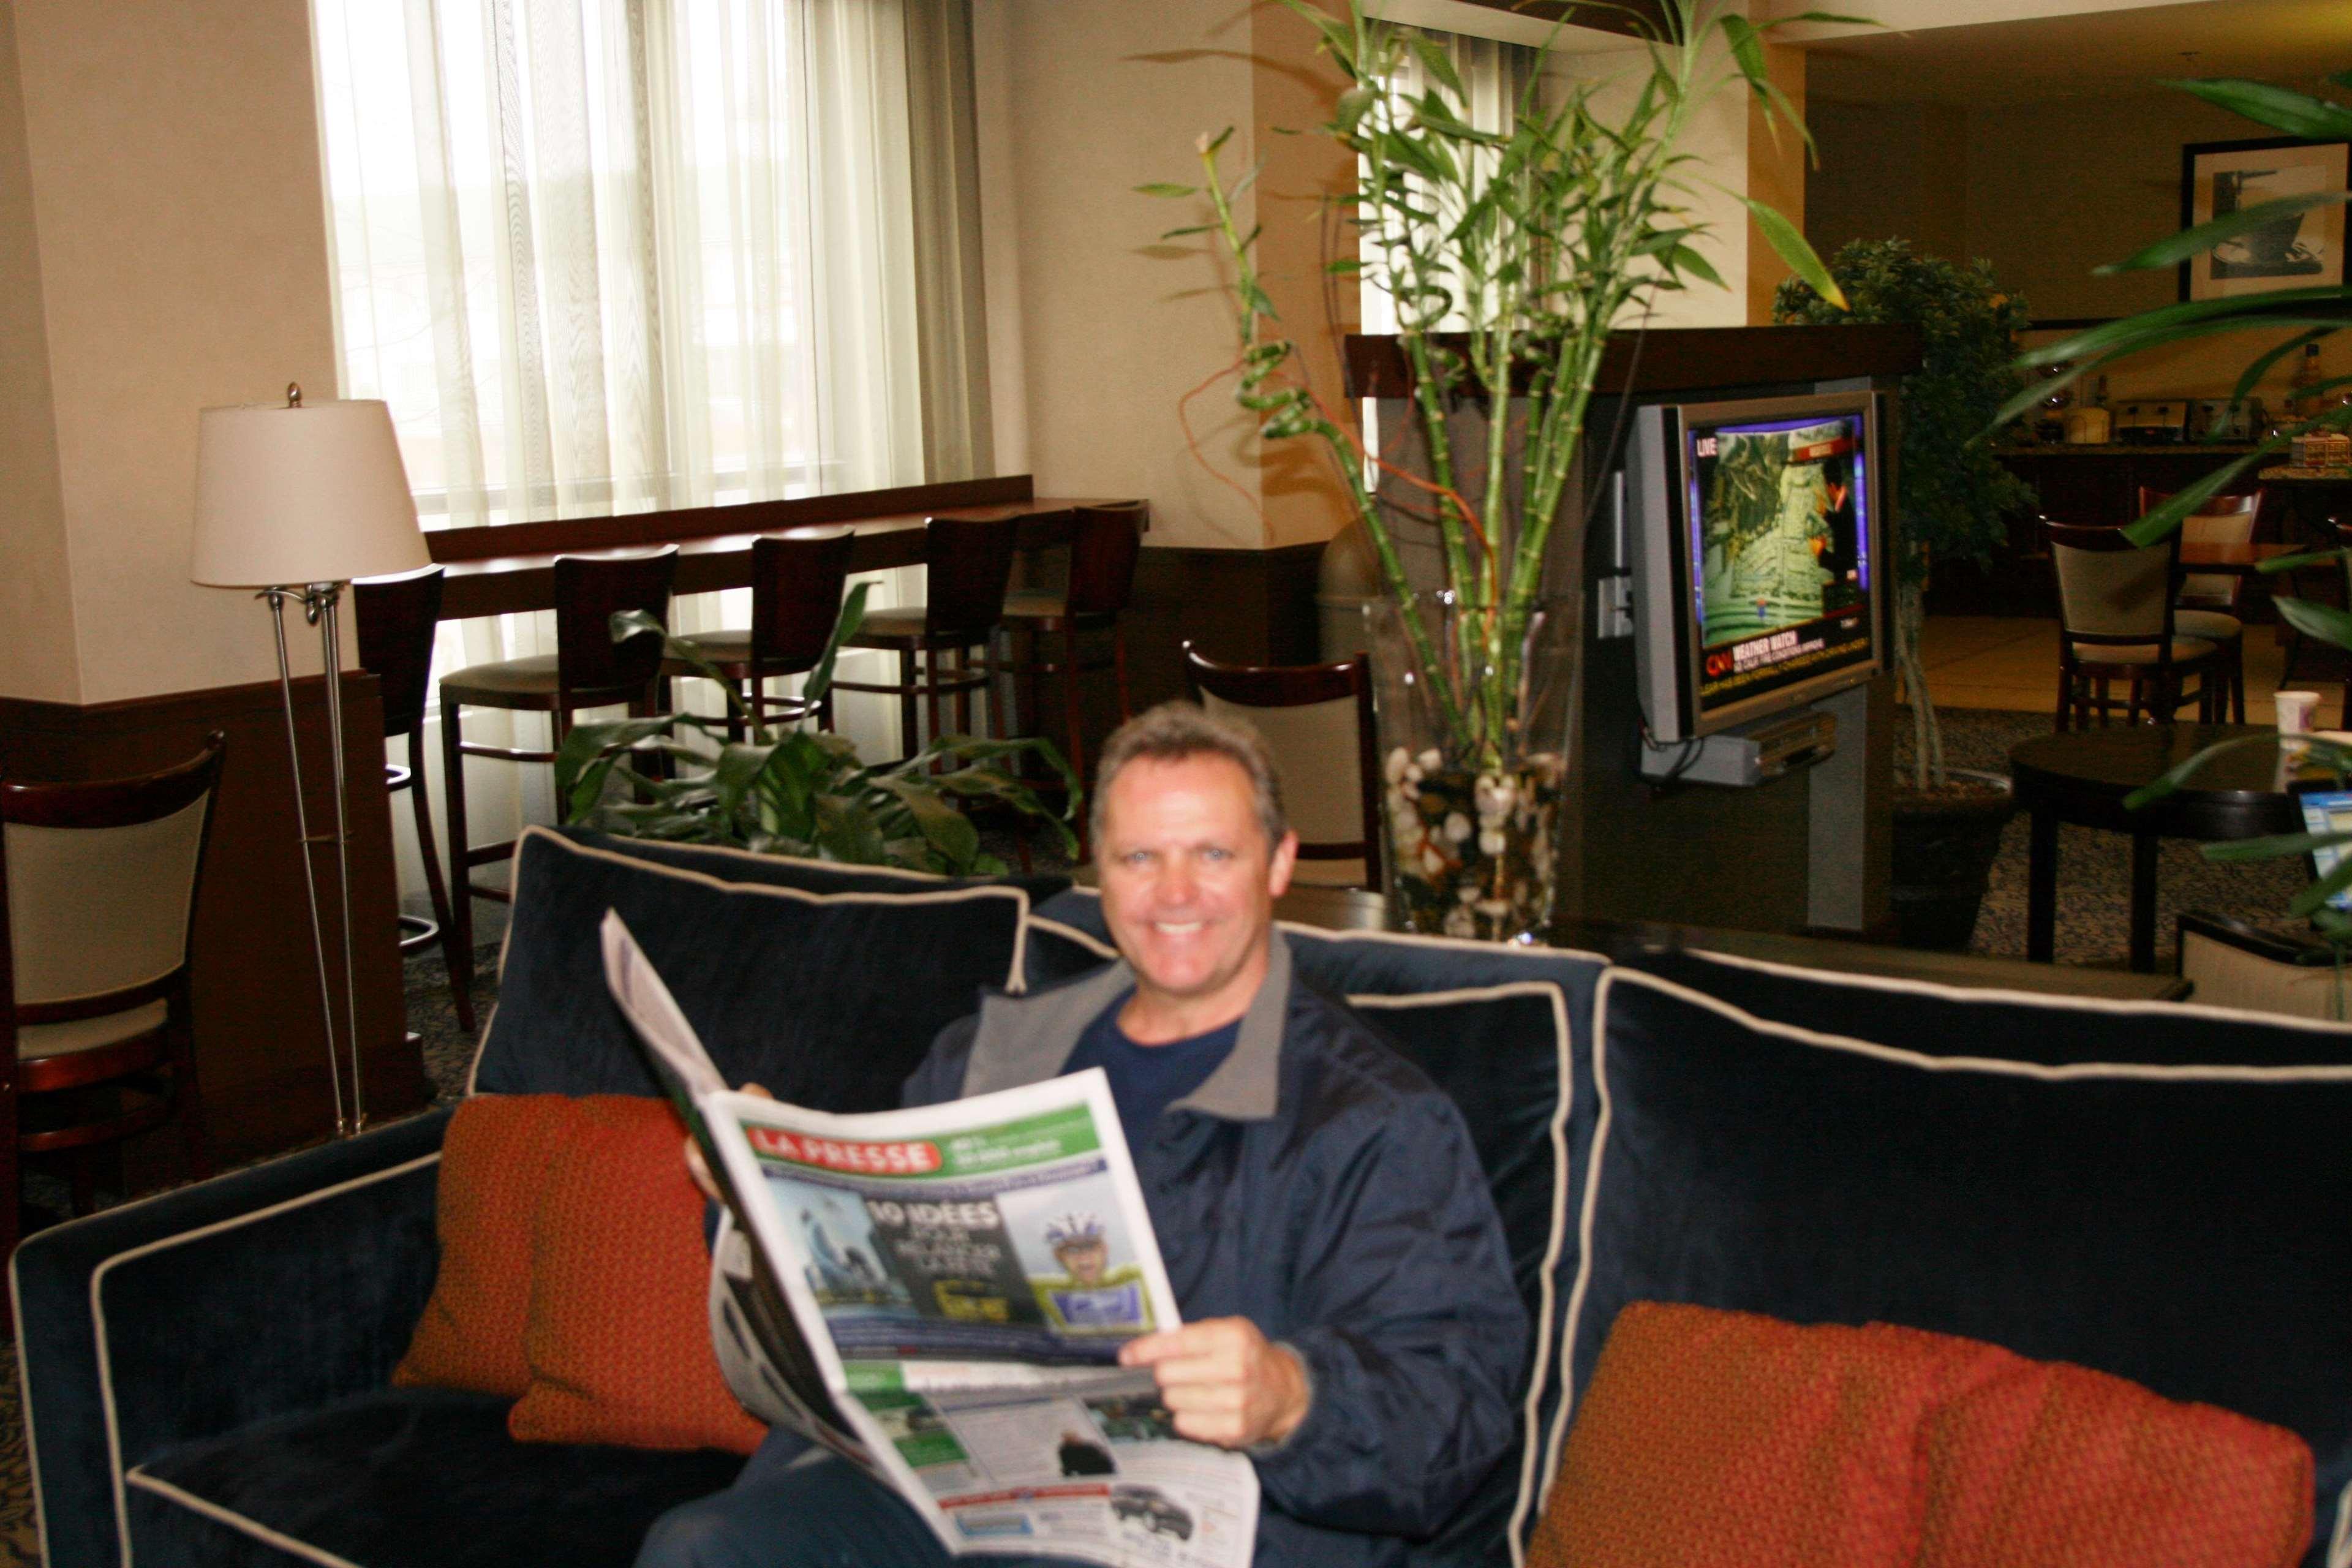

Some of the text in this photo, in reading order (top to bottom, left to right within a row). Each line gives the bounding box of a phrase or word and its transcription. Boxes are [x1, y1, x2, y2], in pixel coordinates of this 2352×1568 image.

[1696, 437, 1717, 457] LIVE
[1733, 630, 1798, 661] WEATHER WATCH
[1706, 648, 1733, 676] CNN
[752, 1129, 799, 1158] LA
[800, 1137, 932, 1172] PRESSE
[867, 1196, 1000, 1229] 10 IDÉES
